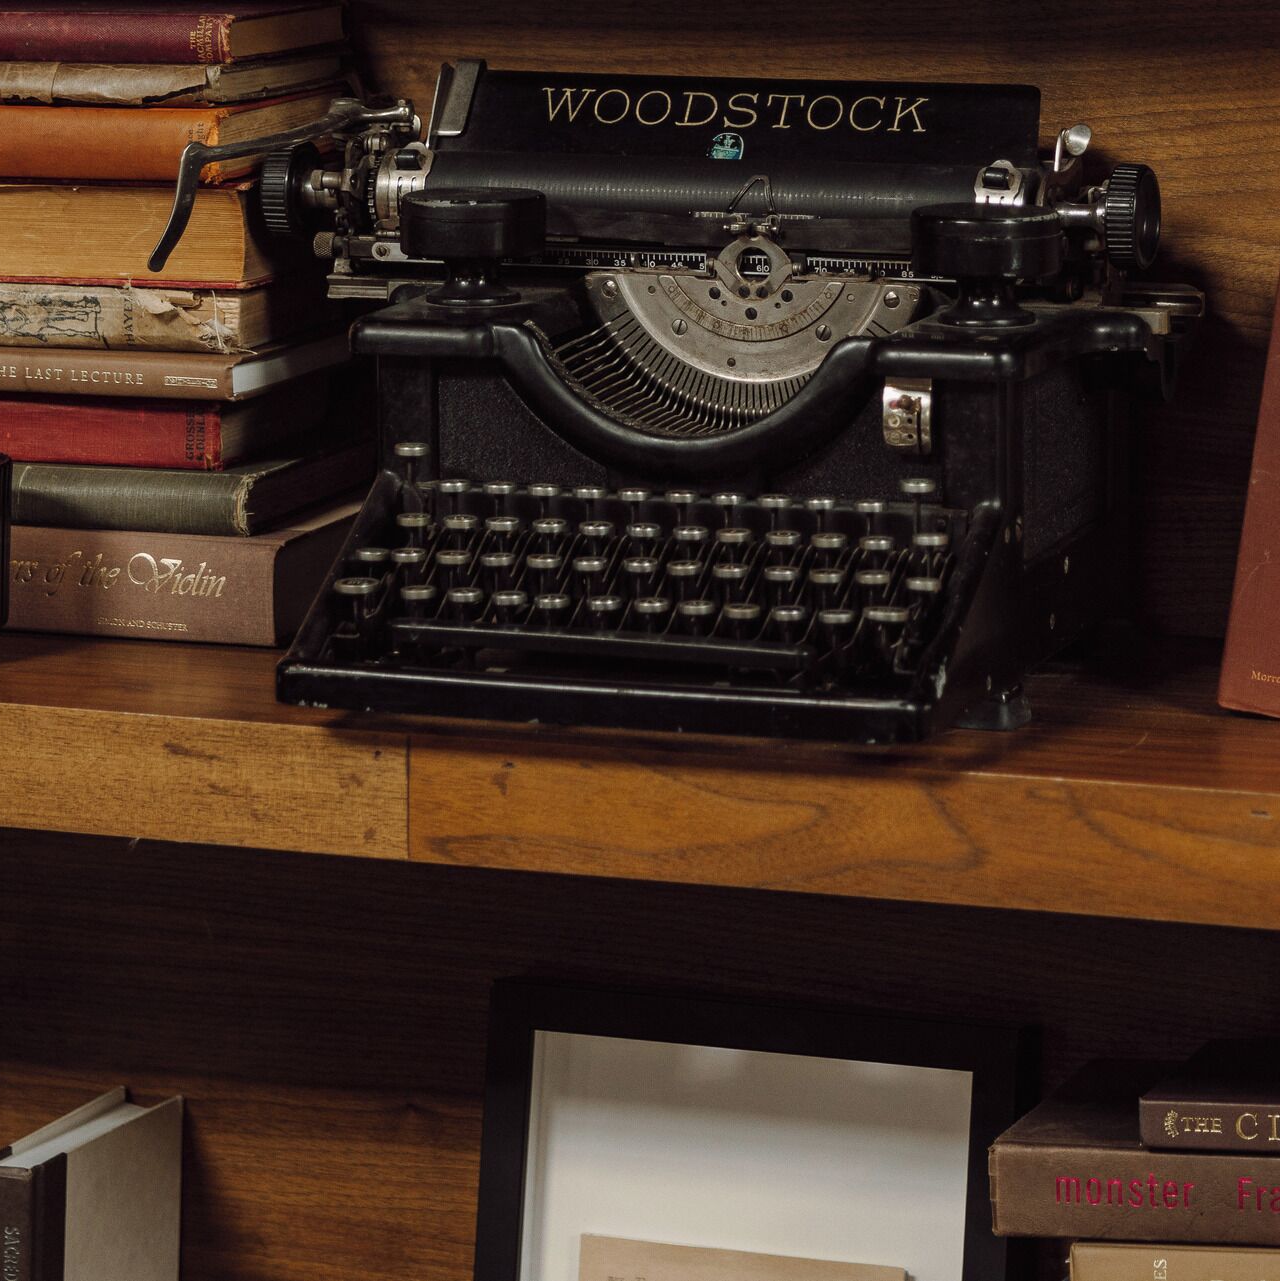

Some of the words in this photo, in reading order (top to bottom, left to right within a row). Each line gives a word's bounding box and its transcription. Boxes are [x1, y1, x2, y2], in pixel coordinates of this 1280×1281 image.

[189, 30, 197, 50] THE
[542, 86, 931, 133] WOODSTOCK
[613, 258, 627, 268] 35
[756, 264, 770, 273] 60
[901, 270, 914, 279] 85
[25, 366, 63, 381] LAST
[70, 368, 145, 386] LECTURE
[44, 549, 83, 597] of
[78, 553, 122, 589] the
[127, 551, 227, 599] Violin
[127, 618, 142, 630] AND
[144, 619, 189, 632] SCHUSTER
[1181, 1117, 1223, 1135] THE
[1055, 1171, 1195, 1211] monster
